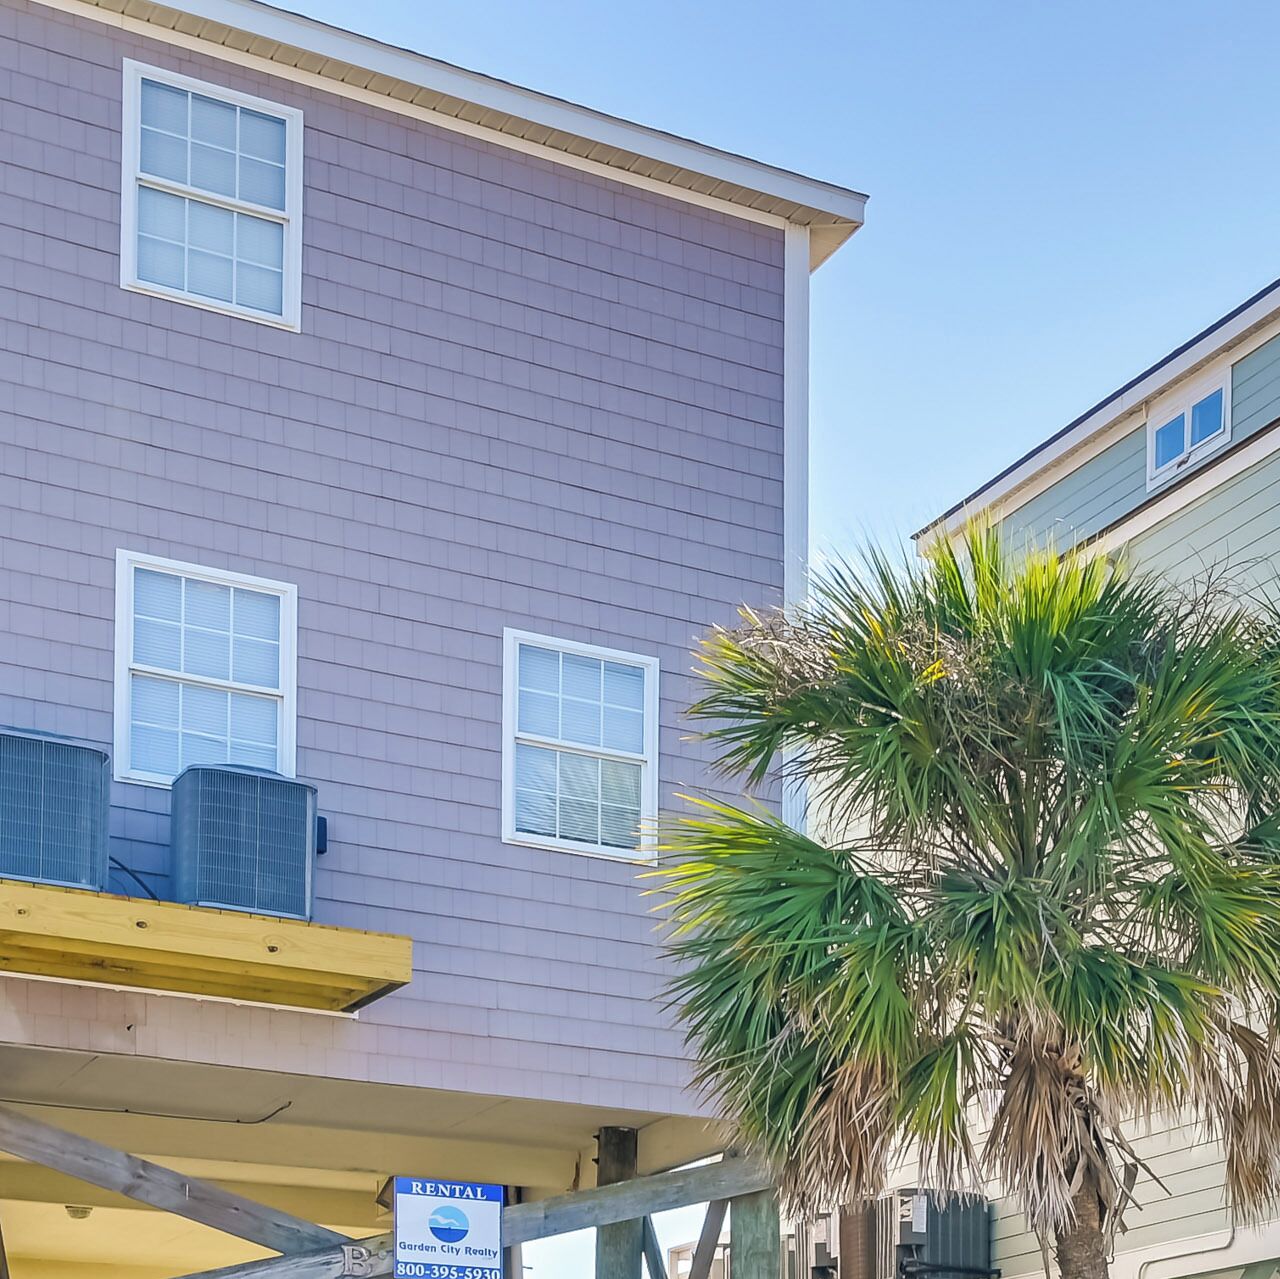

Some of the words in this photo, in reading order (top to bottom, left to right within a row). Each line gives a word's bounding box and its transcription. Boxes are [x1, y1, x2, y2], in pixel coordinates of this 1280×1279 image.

[411, 1181, 486, 1200] RENTAL
[399, 1241, 437, 1253] Garden
[440, 1244, 460, 1256] City
[465, 1246, 498, 1259] Realty
[341, 1245, 373, 1278] B
